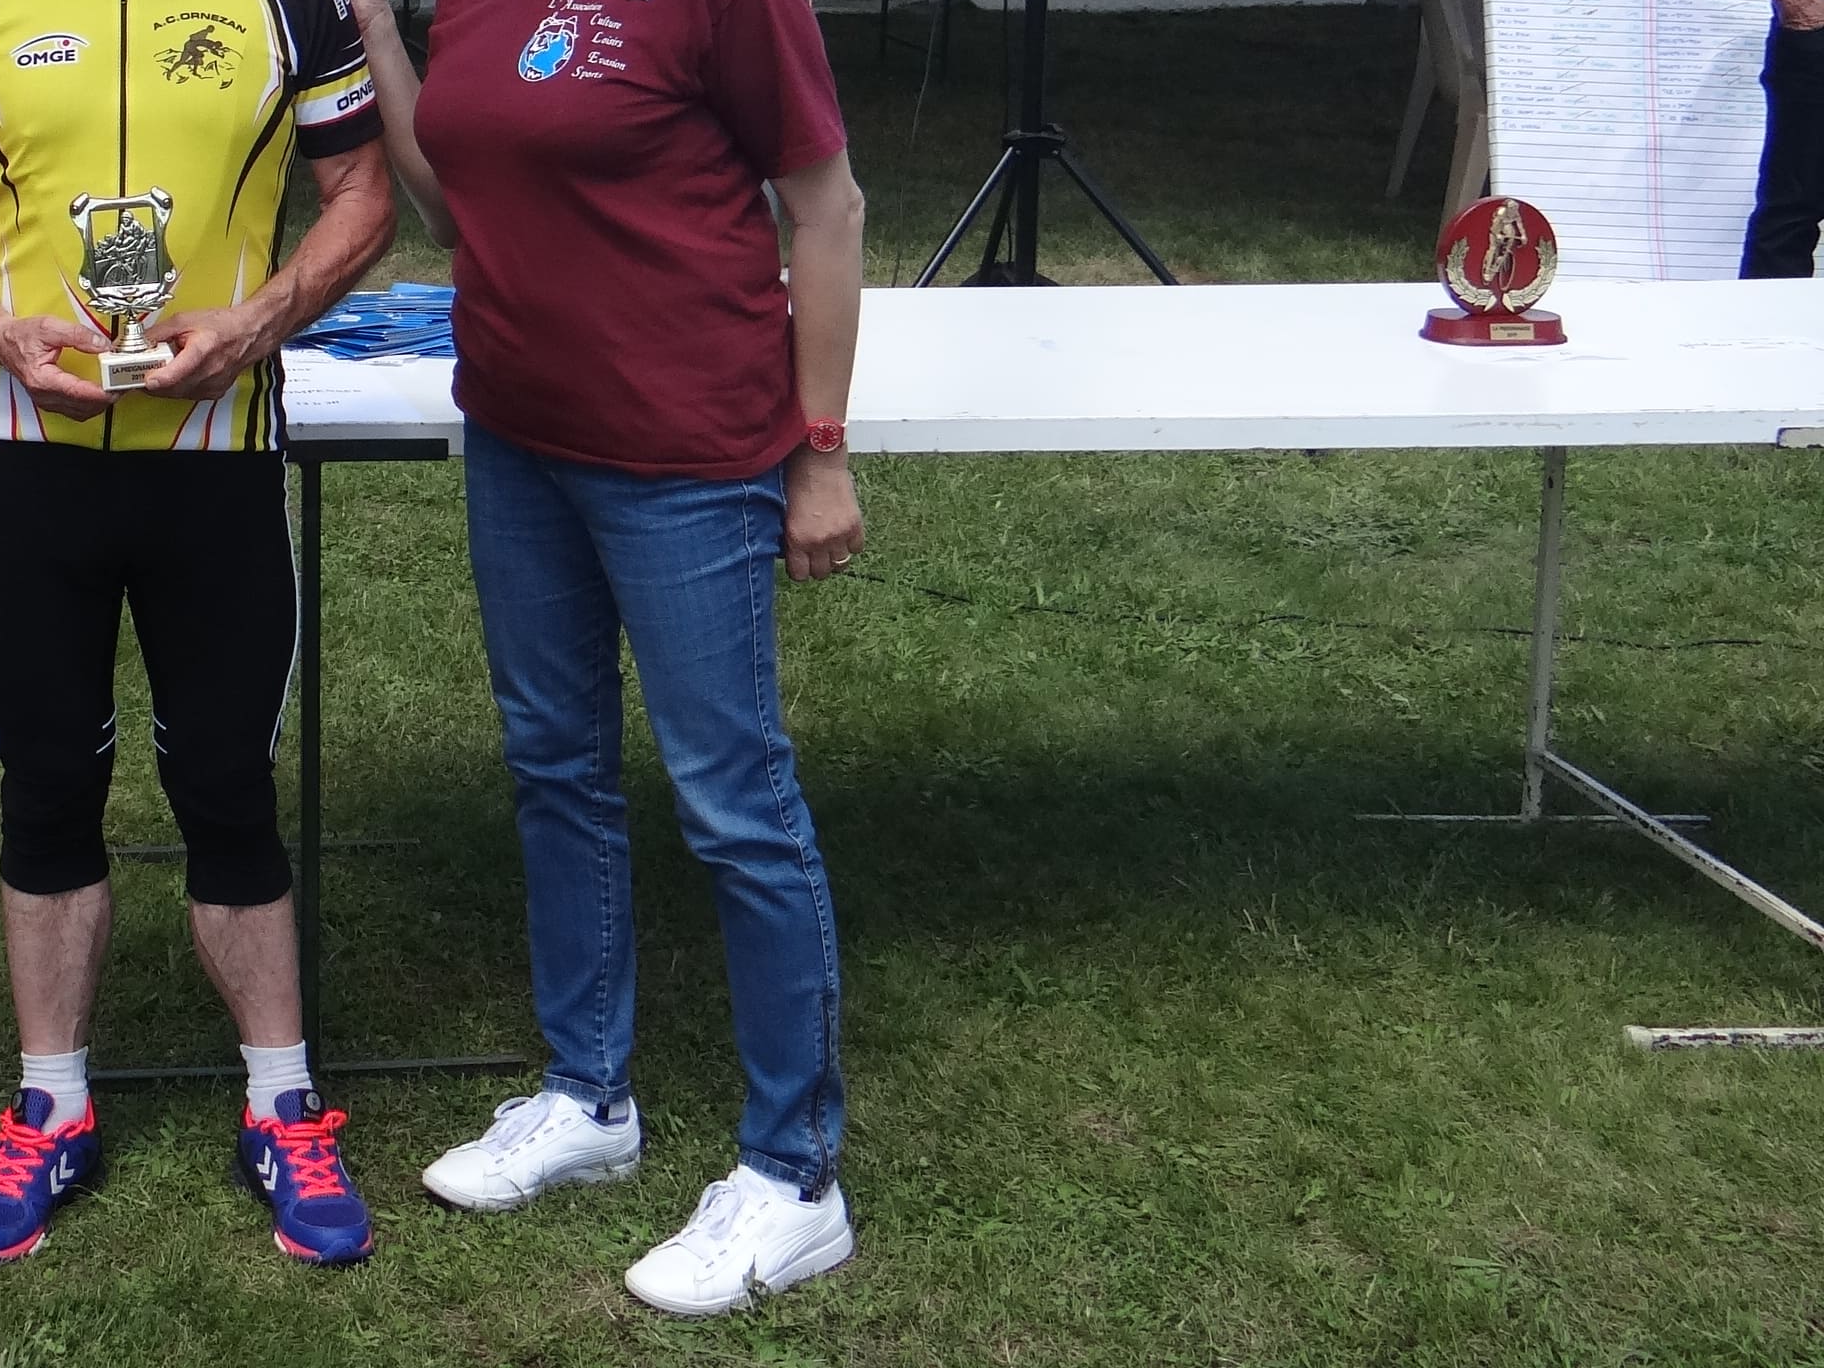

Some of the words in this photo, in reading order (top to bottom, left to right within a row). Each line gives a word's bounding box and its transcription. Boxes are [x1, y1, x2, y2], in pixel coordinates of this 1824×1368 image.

[589, 12, 623, 30] Culture
[591, 31, 624, 48] Loisirs
[17, 49, 76, 66] OMGE
[587, 51, 627, 71] Evasion
[570, 65, 604, 80] Sports
